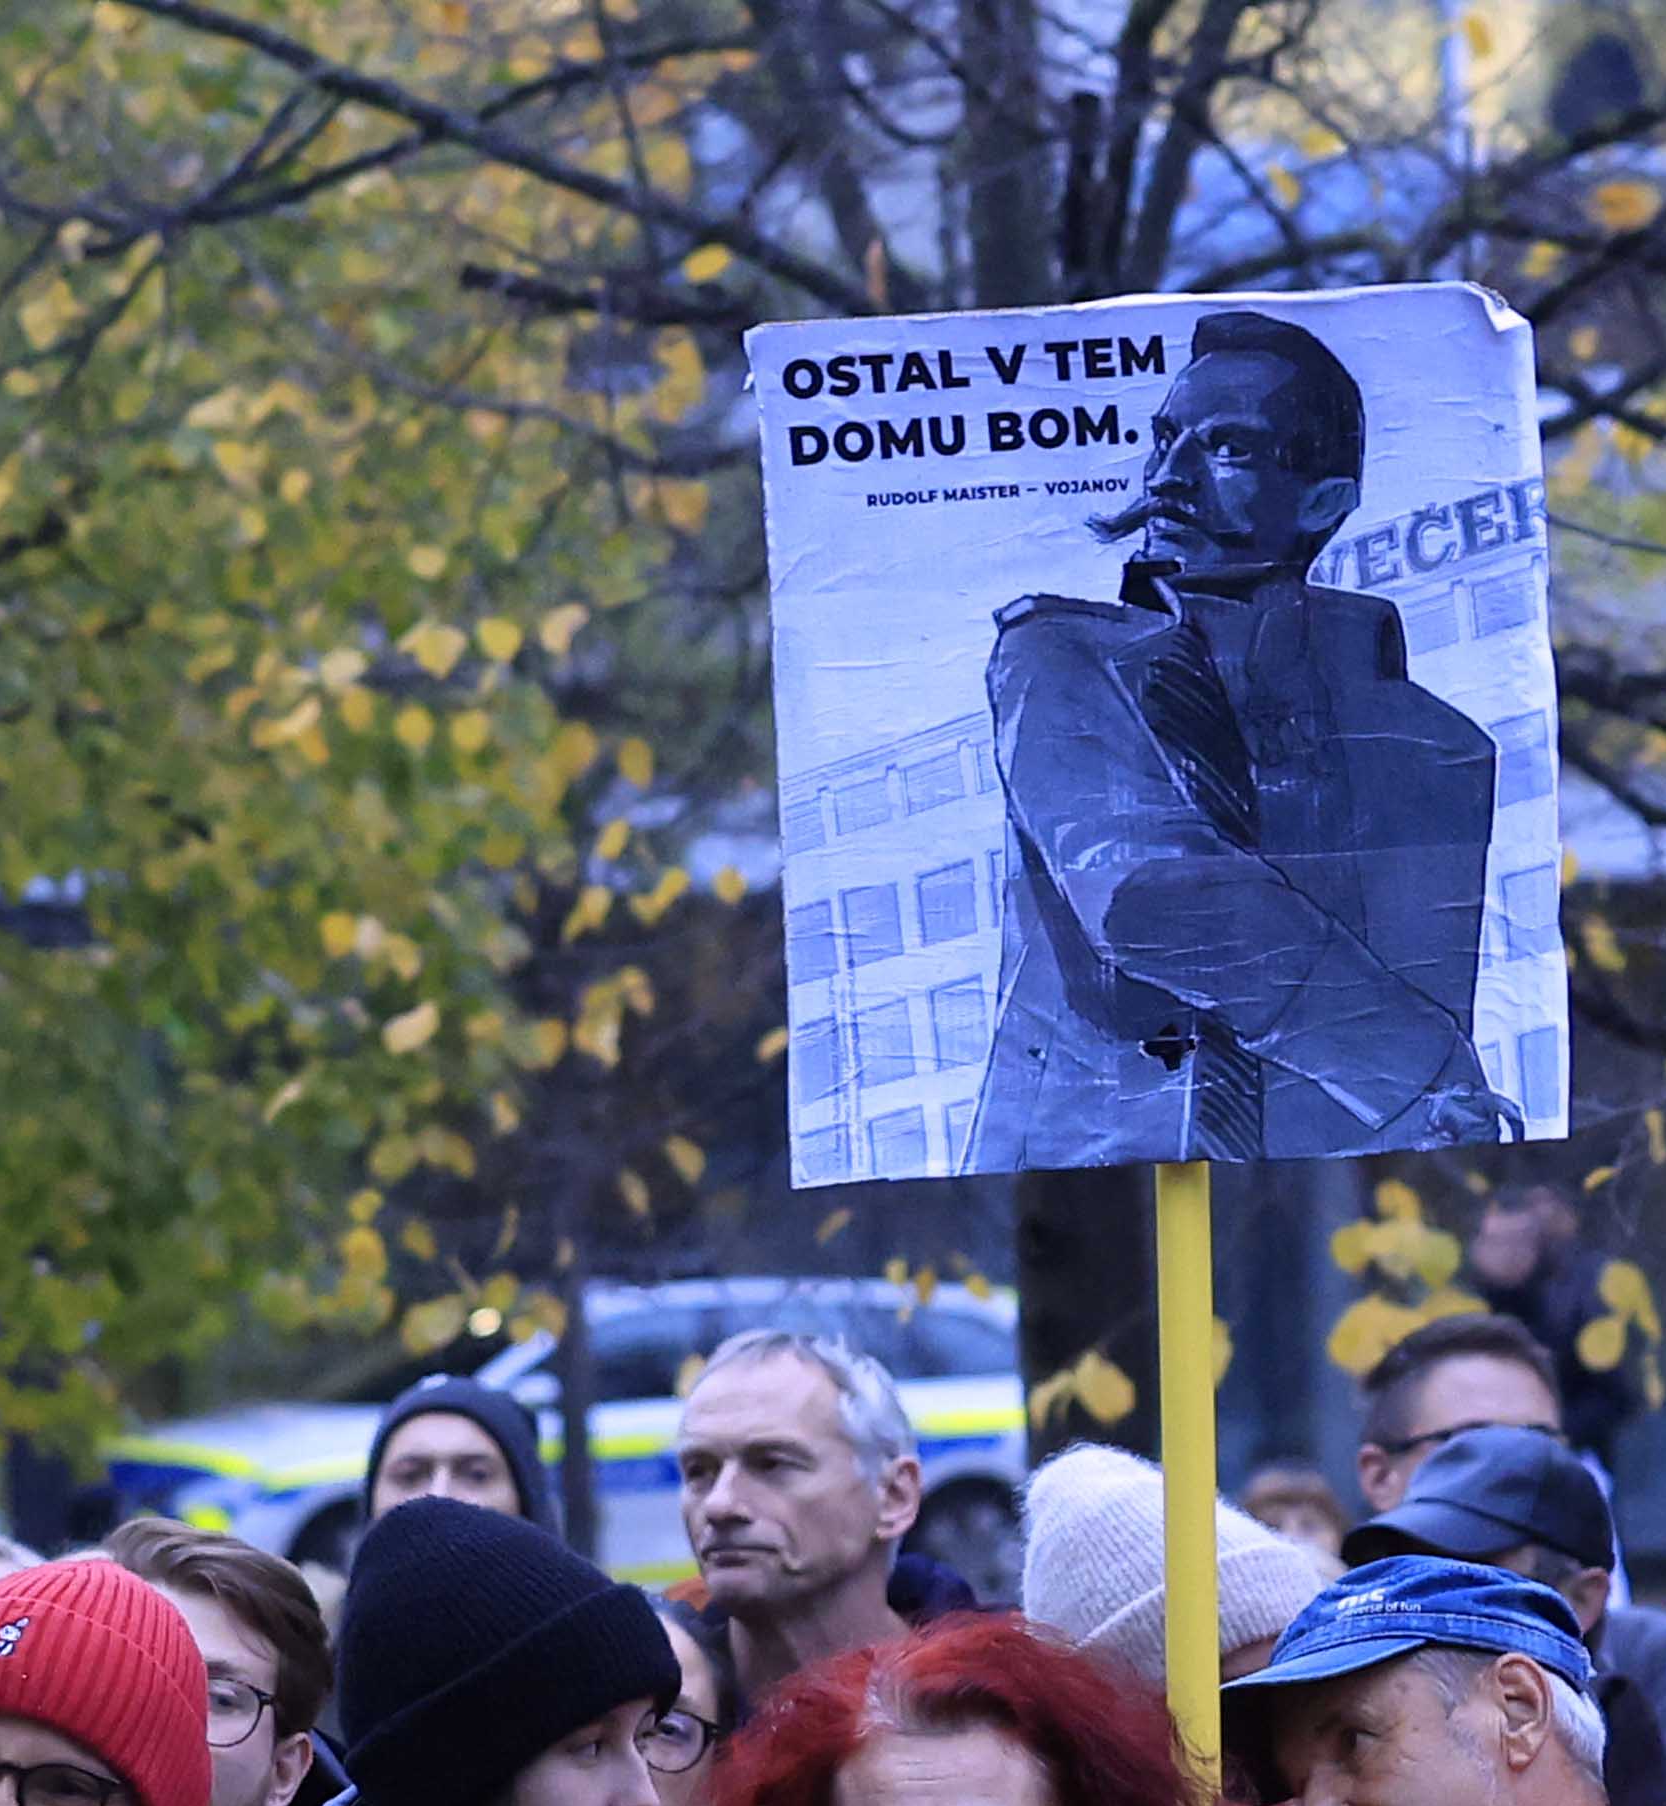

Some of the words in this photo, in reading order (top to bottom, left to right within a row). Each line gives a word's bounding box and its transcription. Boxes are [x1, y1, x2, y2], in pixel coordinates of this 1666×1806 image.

[782, 350, 971, 400] OSTAL
[985, 343, 1027, 386] V
[1044, 335, 1166, 382] TEM
[789, 414, 966, 467] DOMU
[987, 404, 1139, 453] BOM.
[867, 489, 938, 508] RUDOLF
[942, 483, 1020, 503] MAISTER
[1044, 478, 1131, 496] VOJANOV
